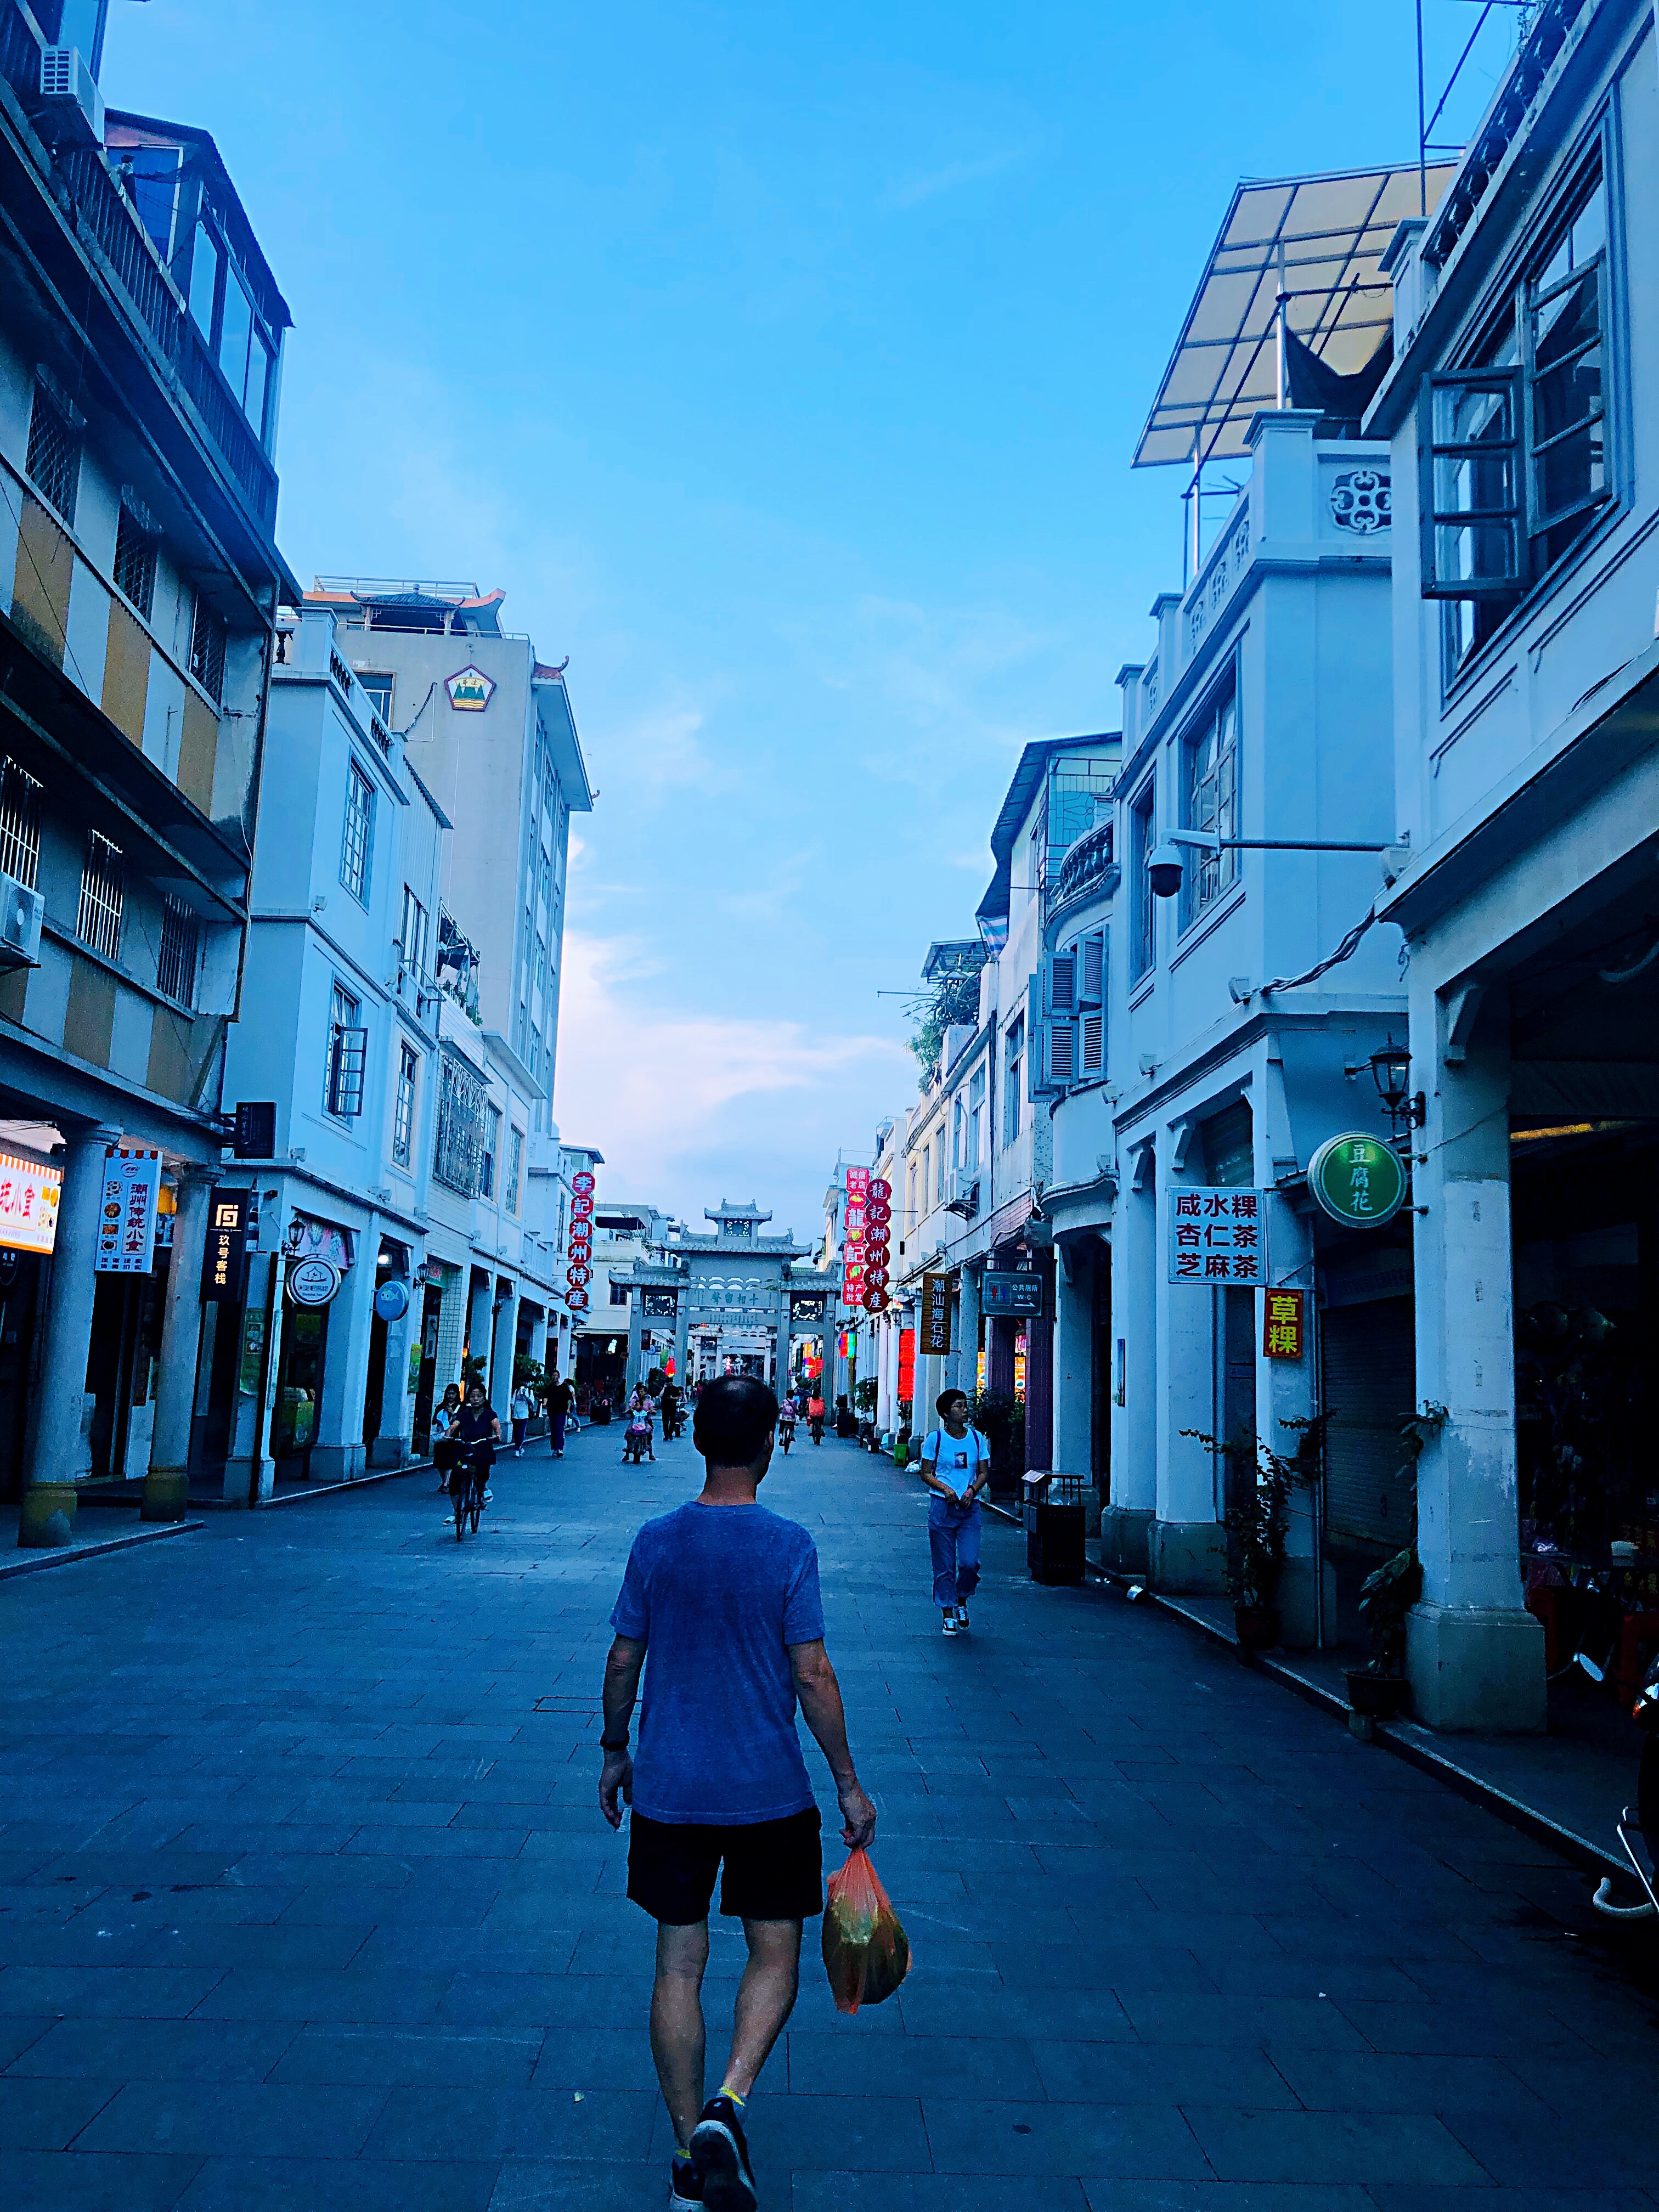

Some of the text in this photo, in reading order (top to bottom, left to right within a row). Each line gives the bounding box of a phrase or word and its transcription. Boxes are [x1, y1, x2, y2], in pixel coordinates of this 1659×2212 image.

[849, 1181, 866, 1189] 老店
[850, 1170, 866, 1180] 诚信
[1348, 1144, 1373, 1212] 豆腐花
[1176, 1193, 1258, 1218] 咸水粿
[567, 1175, 592, 1307] 李記潮州特産
[1176, 1223, 1259, 1248] 杏仁茶
[215, 1234, 230, 1284] 玖号客栈
[1176, 1252, 1259, 1278] 芝麻茶
[846, 1294, 862, 1302] 批发
[847, 1284, 863, 1293] 特产
[1012, 1284, 1038, 1292] 公共厕所
[930, 1279, 945, 1348] 潮汕海石花
[1269, 1295, 1299, 1354] 草粿
